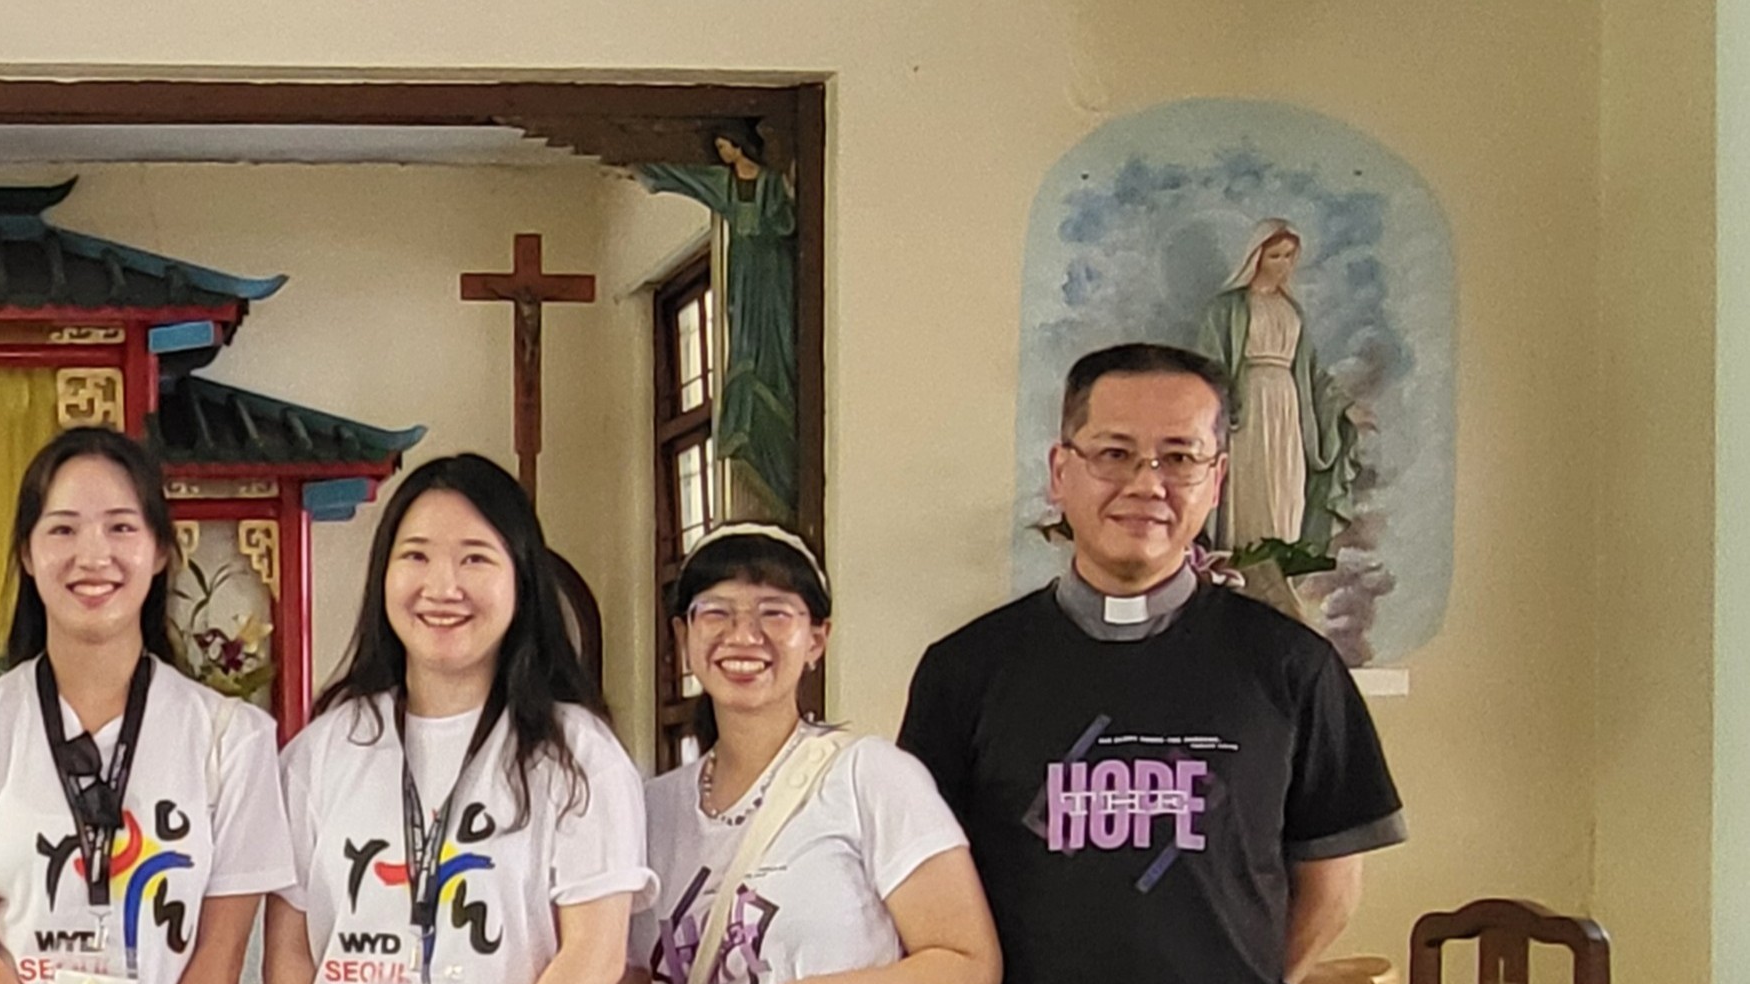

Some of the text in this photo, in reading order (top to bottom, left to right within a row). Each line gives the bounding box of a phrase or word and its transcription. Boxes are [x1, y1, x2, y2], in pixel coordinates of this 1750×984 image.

[1047, 759, 1208, 851] HOPE
[1060, 790, 1190, 816] THE
[338, 932, 402, 954] WYD
